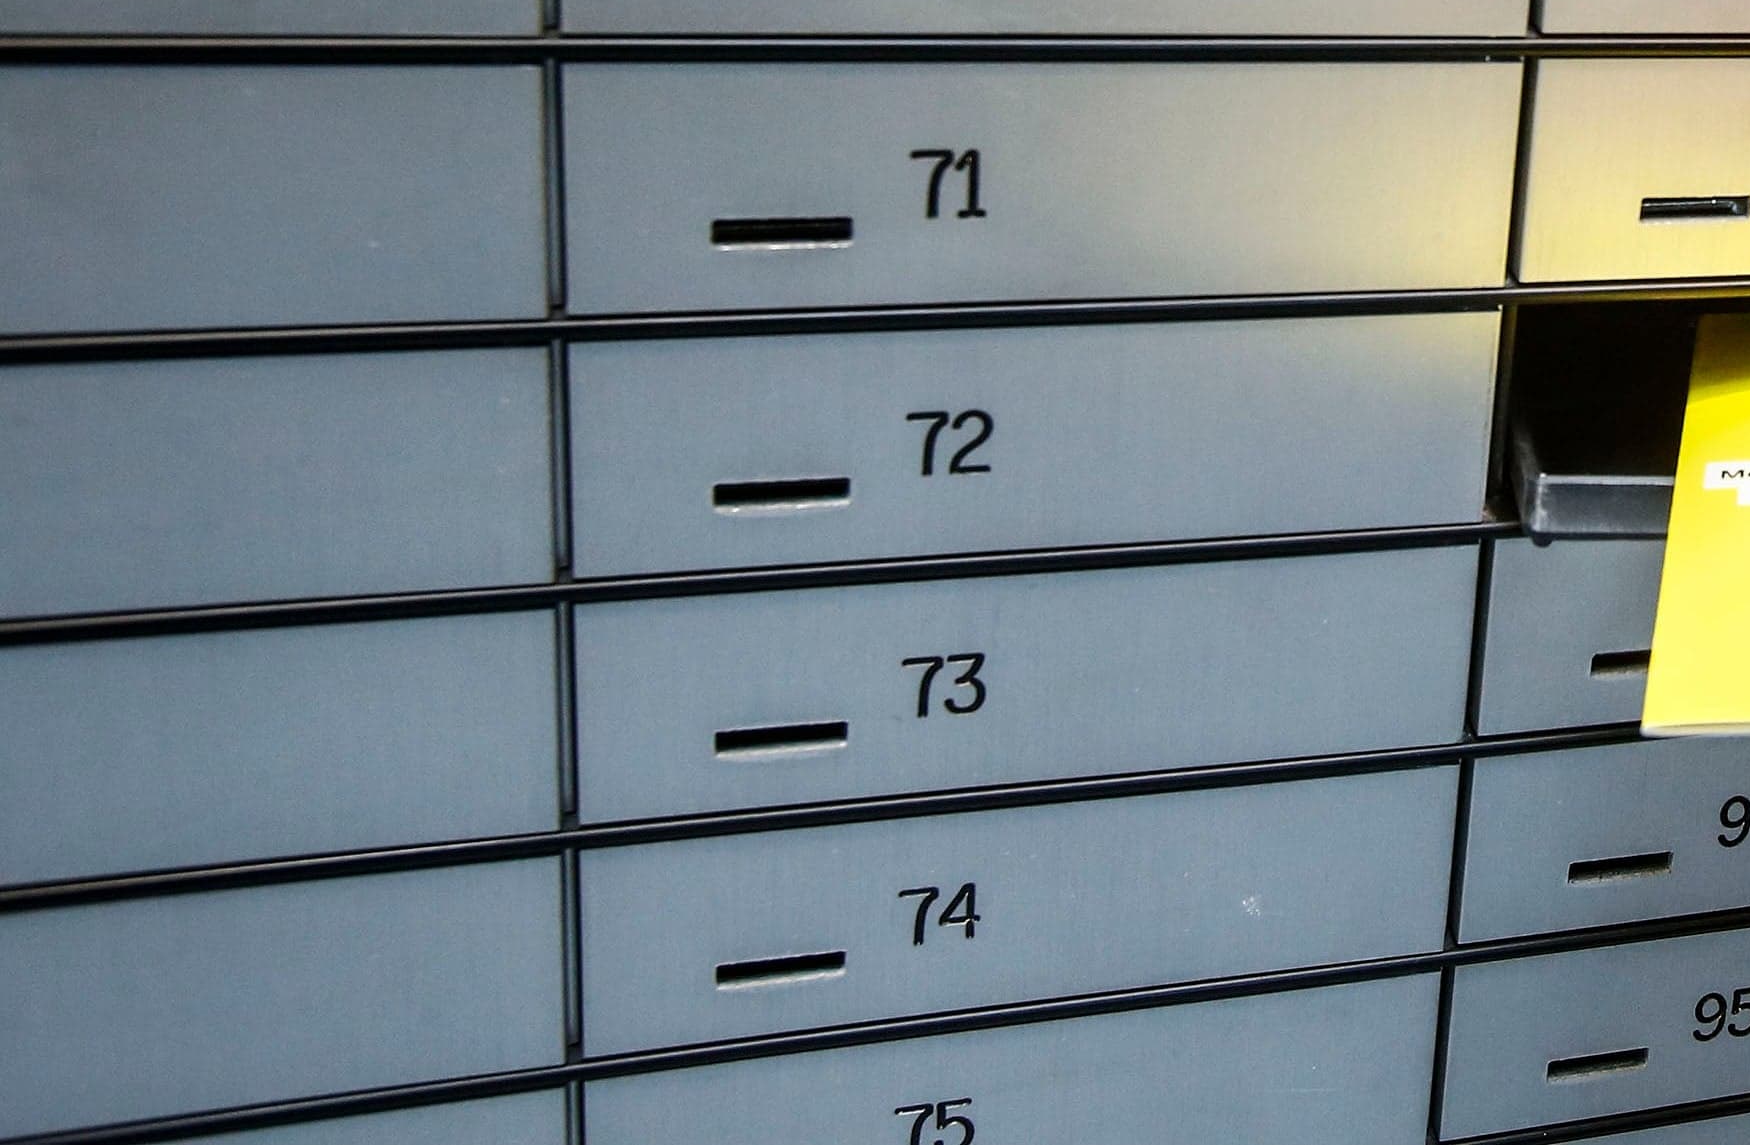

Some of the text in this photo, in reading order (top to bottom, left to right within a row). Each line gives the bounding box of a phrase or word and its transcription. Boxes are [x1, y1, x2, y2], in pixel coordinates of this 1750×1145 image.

[909, 148, 987, 219] 71
[905, 409, 994, 477] 72
[901, 652, 987, 719] 73
[897, 882, 981, 947] 74
[893, 1097, 975, 1145] 75
